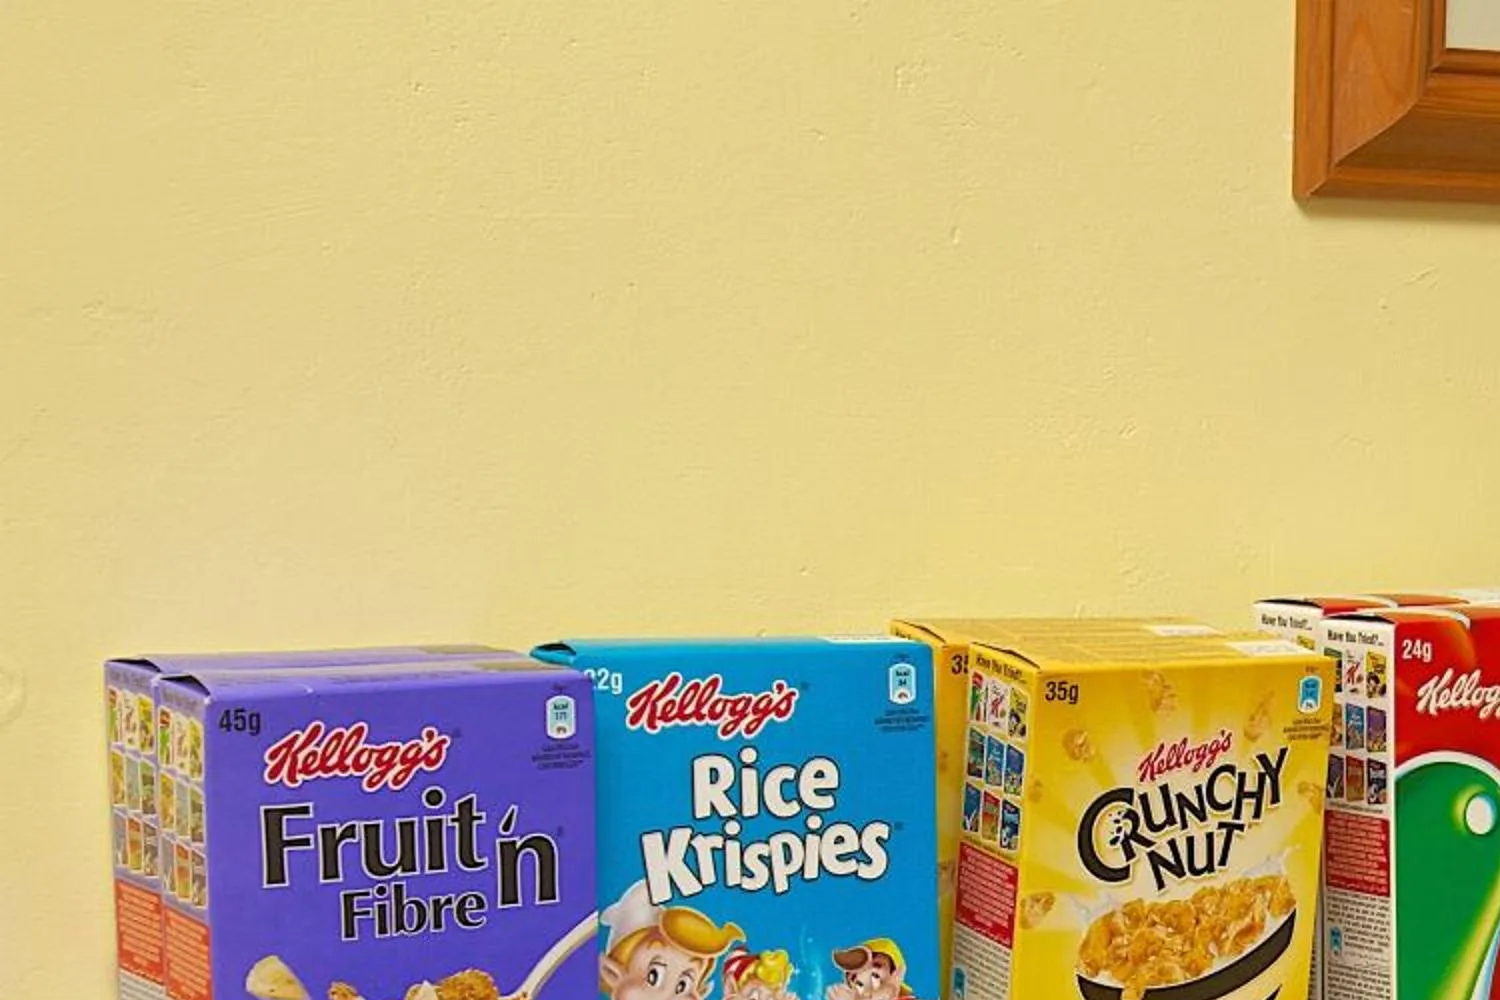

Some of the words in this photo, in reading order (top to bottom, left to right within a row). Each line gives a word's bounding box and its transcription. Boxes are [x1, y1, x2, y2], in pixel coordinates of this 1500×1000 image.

[1402, 638, 1433, 663] 24g
[218, 707, 262, 736] 45g
[626, 671, 800, 740] Kellogg's
[1045, 681, 1079, 705] 35g
[264, 721, 451, 793] Kellogg's
[690, 745, 840, 820] Rice
[1138, 729, 1233, 784] Kellogg's
[259, 786, 487, 889] Fruit
[1076, 747, 1289, 883] CRUNCHY
[640, 814, 892, 905] Krispies
[1146, 821, 1246, 892] NUT
[339, 882, 487, 942] Fibre
